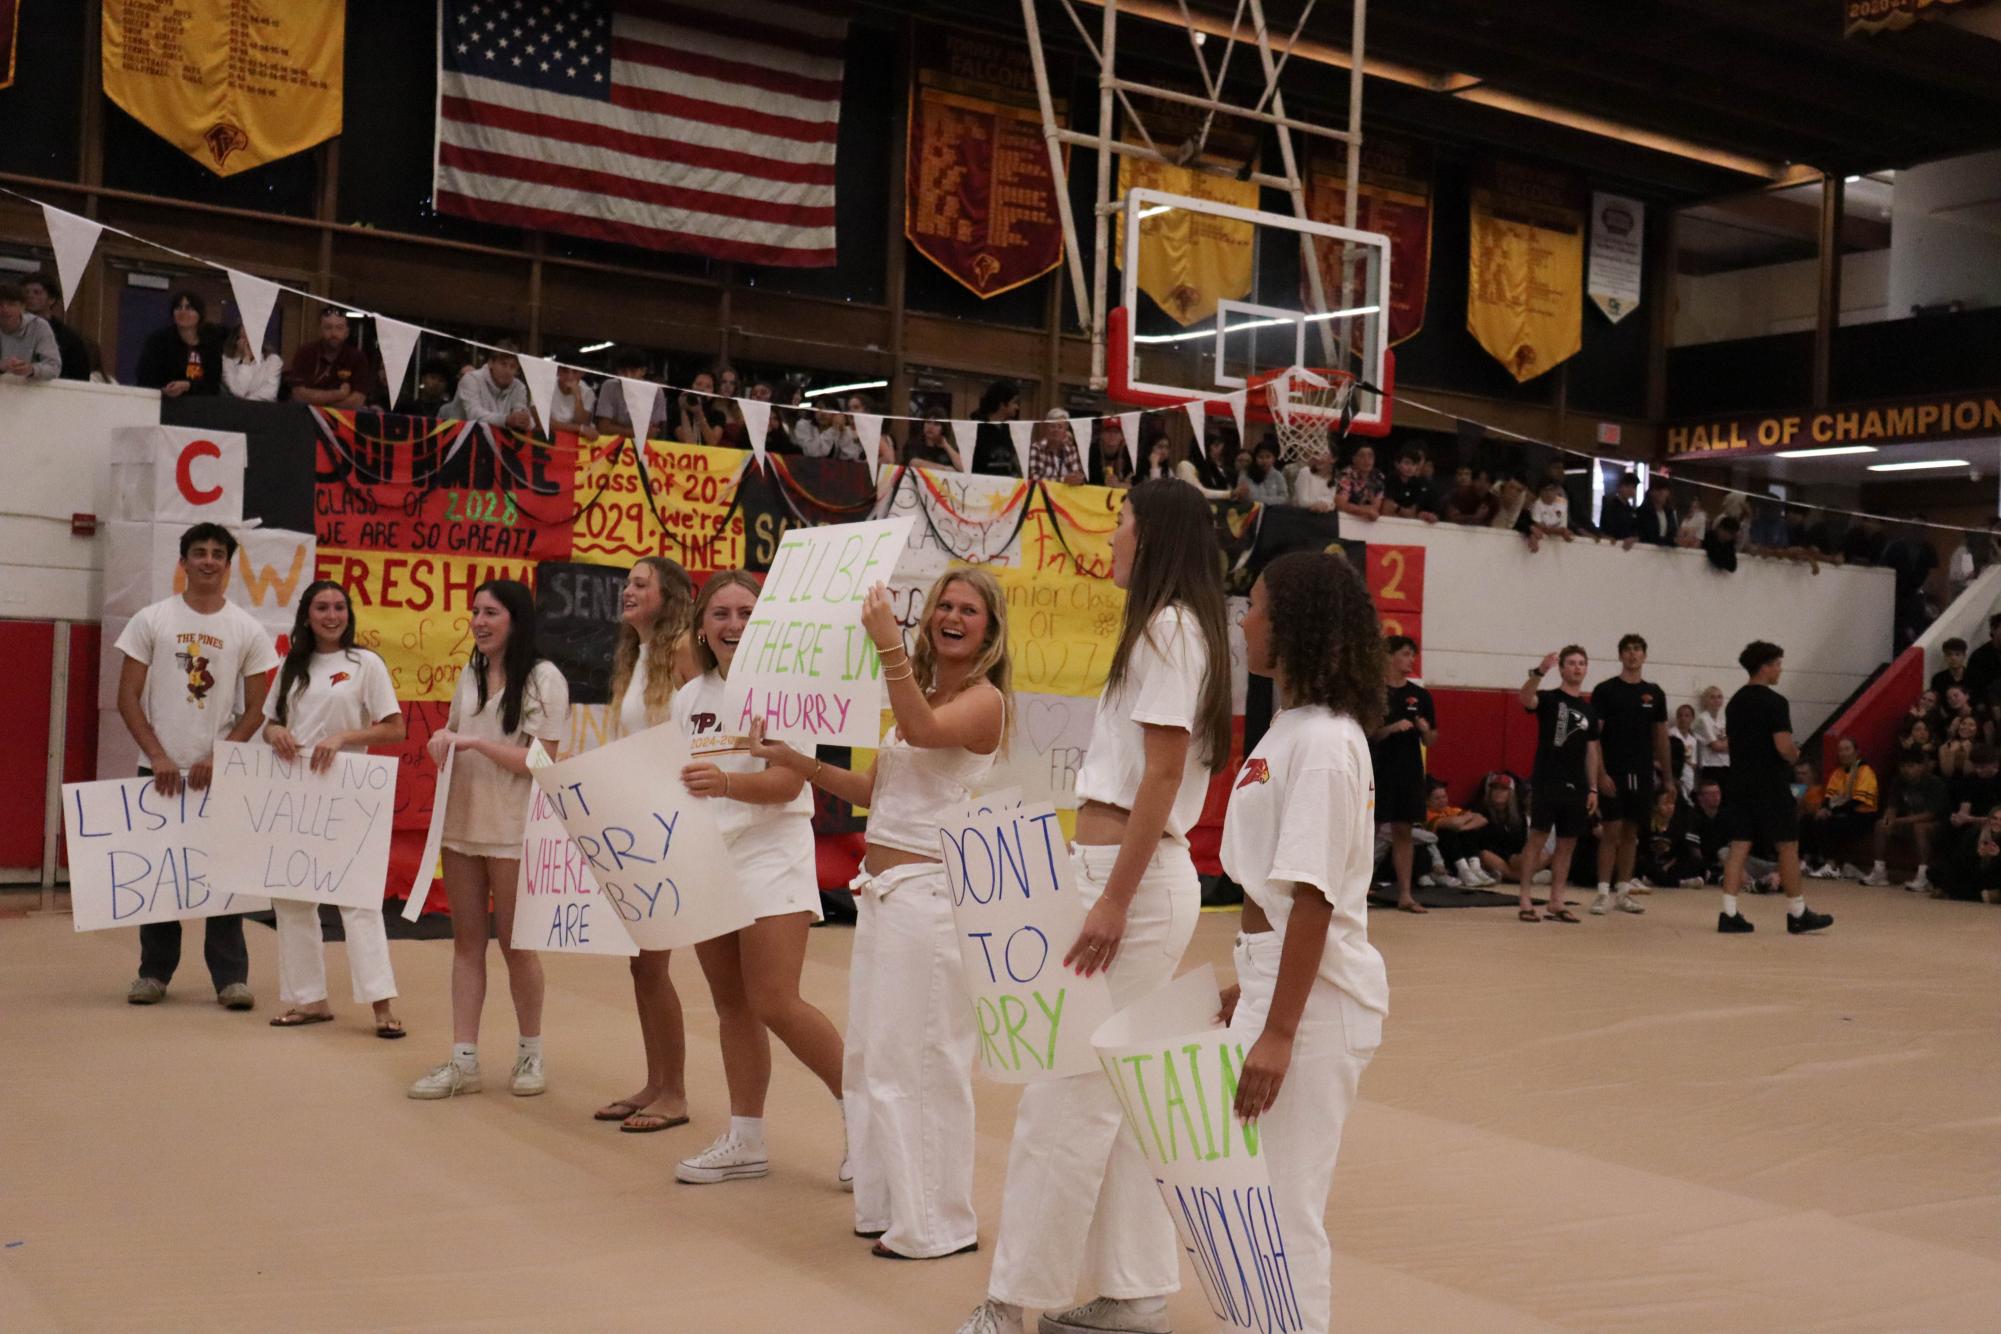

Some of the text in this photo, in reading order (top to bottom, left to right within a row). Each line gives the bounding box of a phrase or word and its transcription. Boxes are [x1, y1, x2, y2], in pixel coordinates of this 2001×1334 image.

[1667, 398, 2001, 455] HALL OF CHAMPION
[176, 440, 223, 506] C
[650, 473, 675, 496] of
[316, 486, 518, 526] CLASS OF 2028
[317, 521, 537, 556] WE ARE SO GREAT!
[659, 531, 737, 571] FINE!
[888, 514, 994, 556] LASSY
[823, 530, 893, 604] BE
[1381, 549, 1407, 600] 2
[176, 633, 225, 651] THE PINES
[402, 618, 433, 650] of
[739, 619, 832, 677] THERE
[841, 624, 881, 682] IN
[738, 687, 852, 736] A HURRY
[342, 757, 388, 791] NO
[244, 789, 381, 856] VALLEY
[577, 811, 679, 872] RRY
[107, 847, 235, 921] BAB
[264, 845, 357, 893] LOW
[940, 812, 1060, 907] DON'T
[547, 903, 592, 948] ARE
[968, 926, 1048, 984] TO
[975, 988, 1066, 1072] RRY
